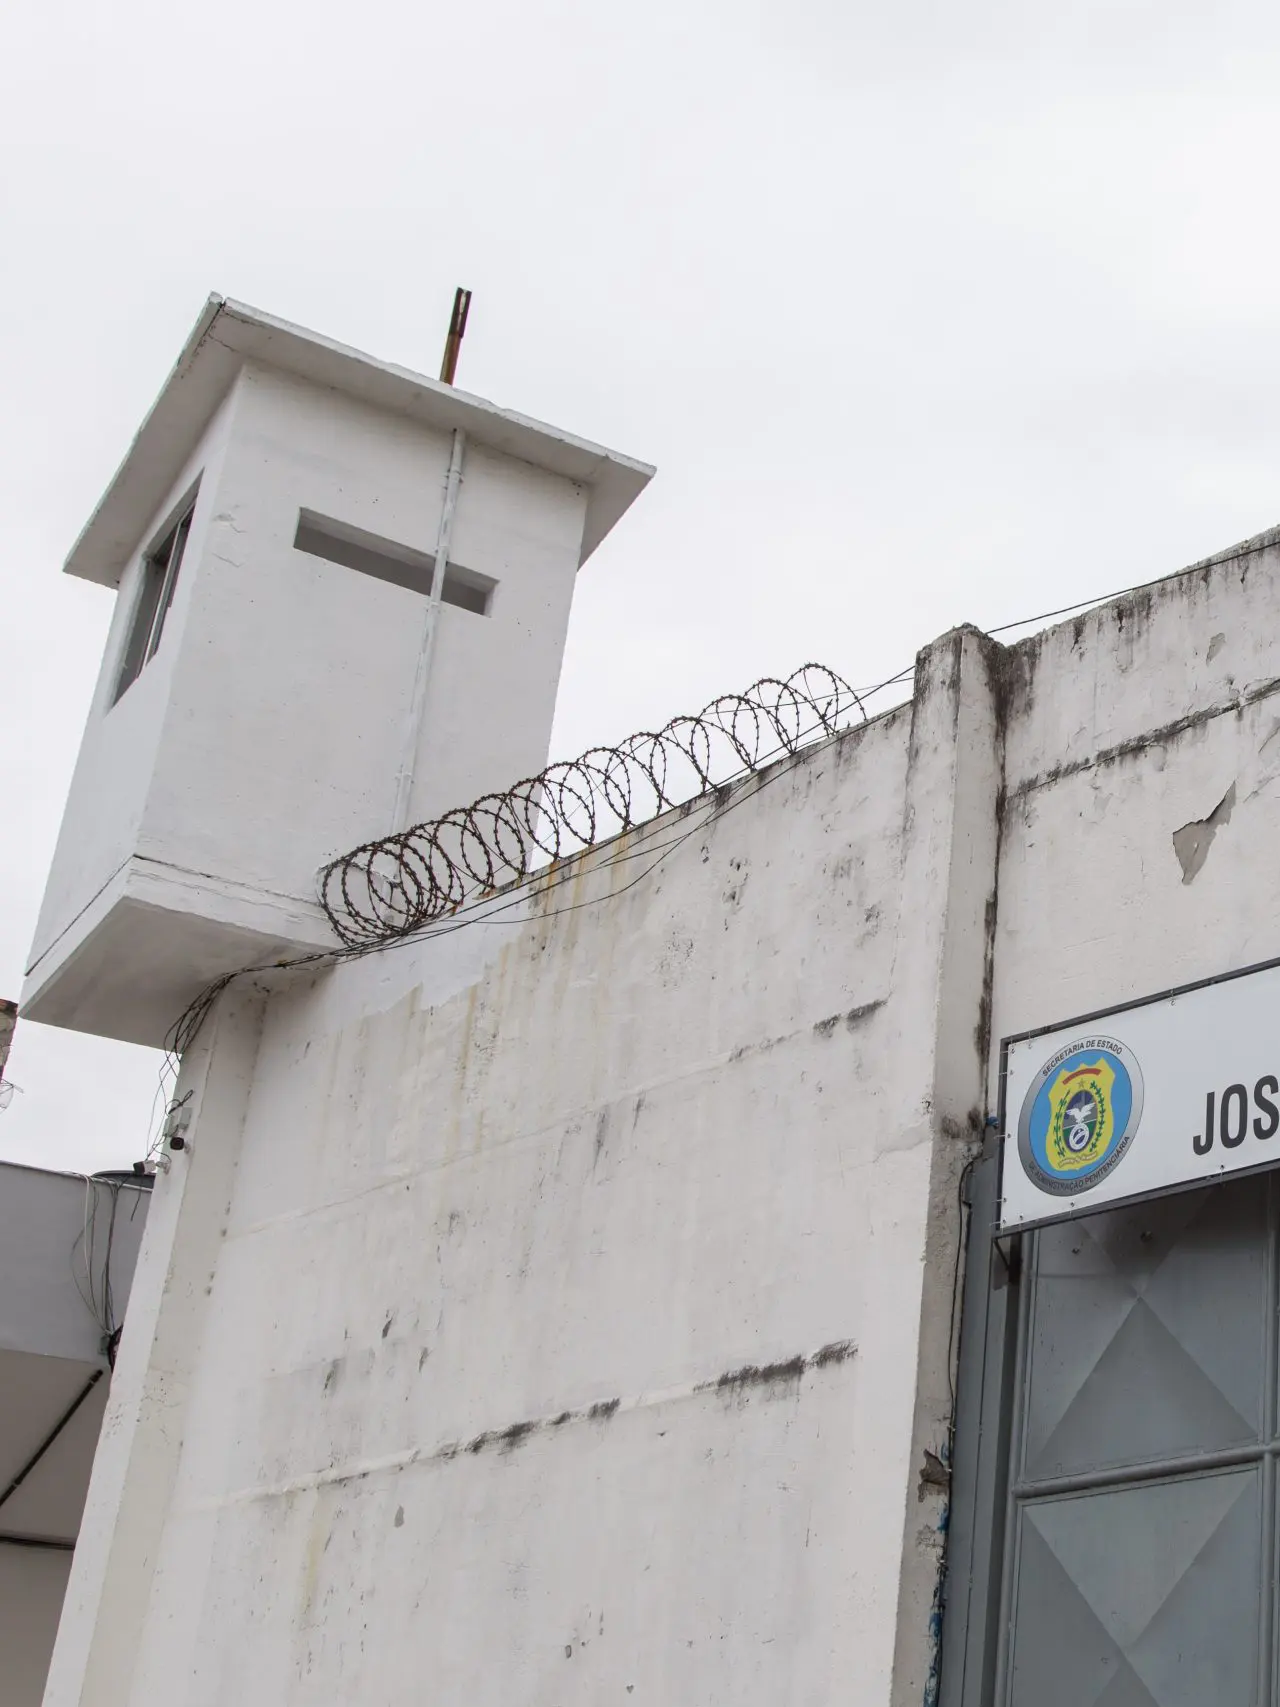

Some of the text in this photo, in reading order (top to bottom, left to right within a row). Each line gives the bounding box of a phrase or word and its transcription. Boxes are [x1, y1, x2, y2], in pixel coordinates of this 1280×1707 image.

[1042, 1040, 1123, 1077] SECRETARIA DE ESTADO
